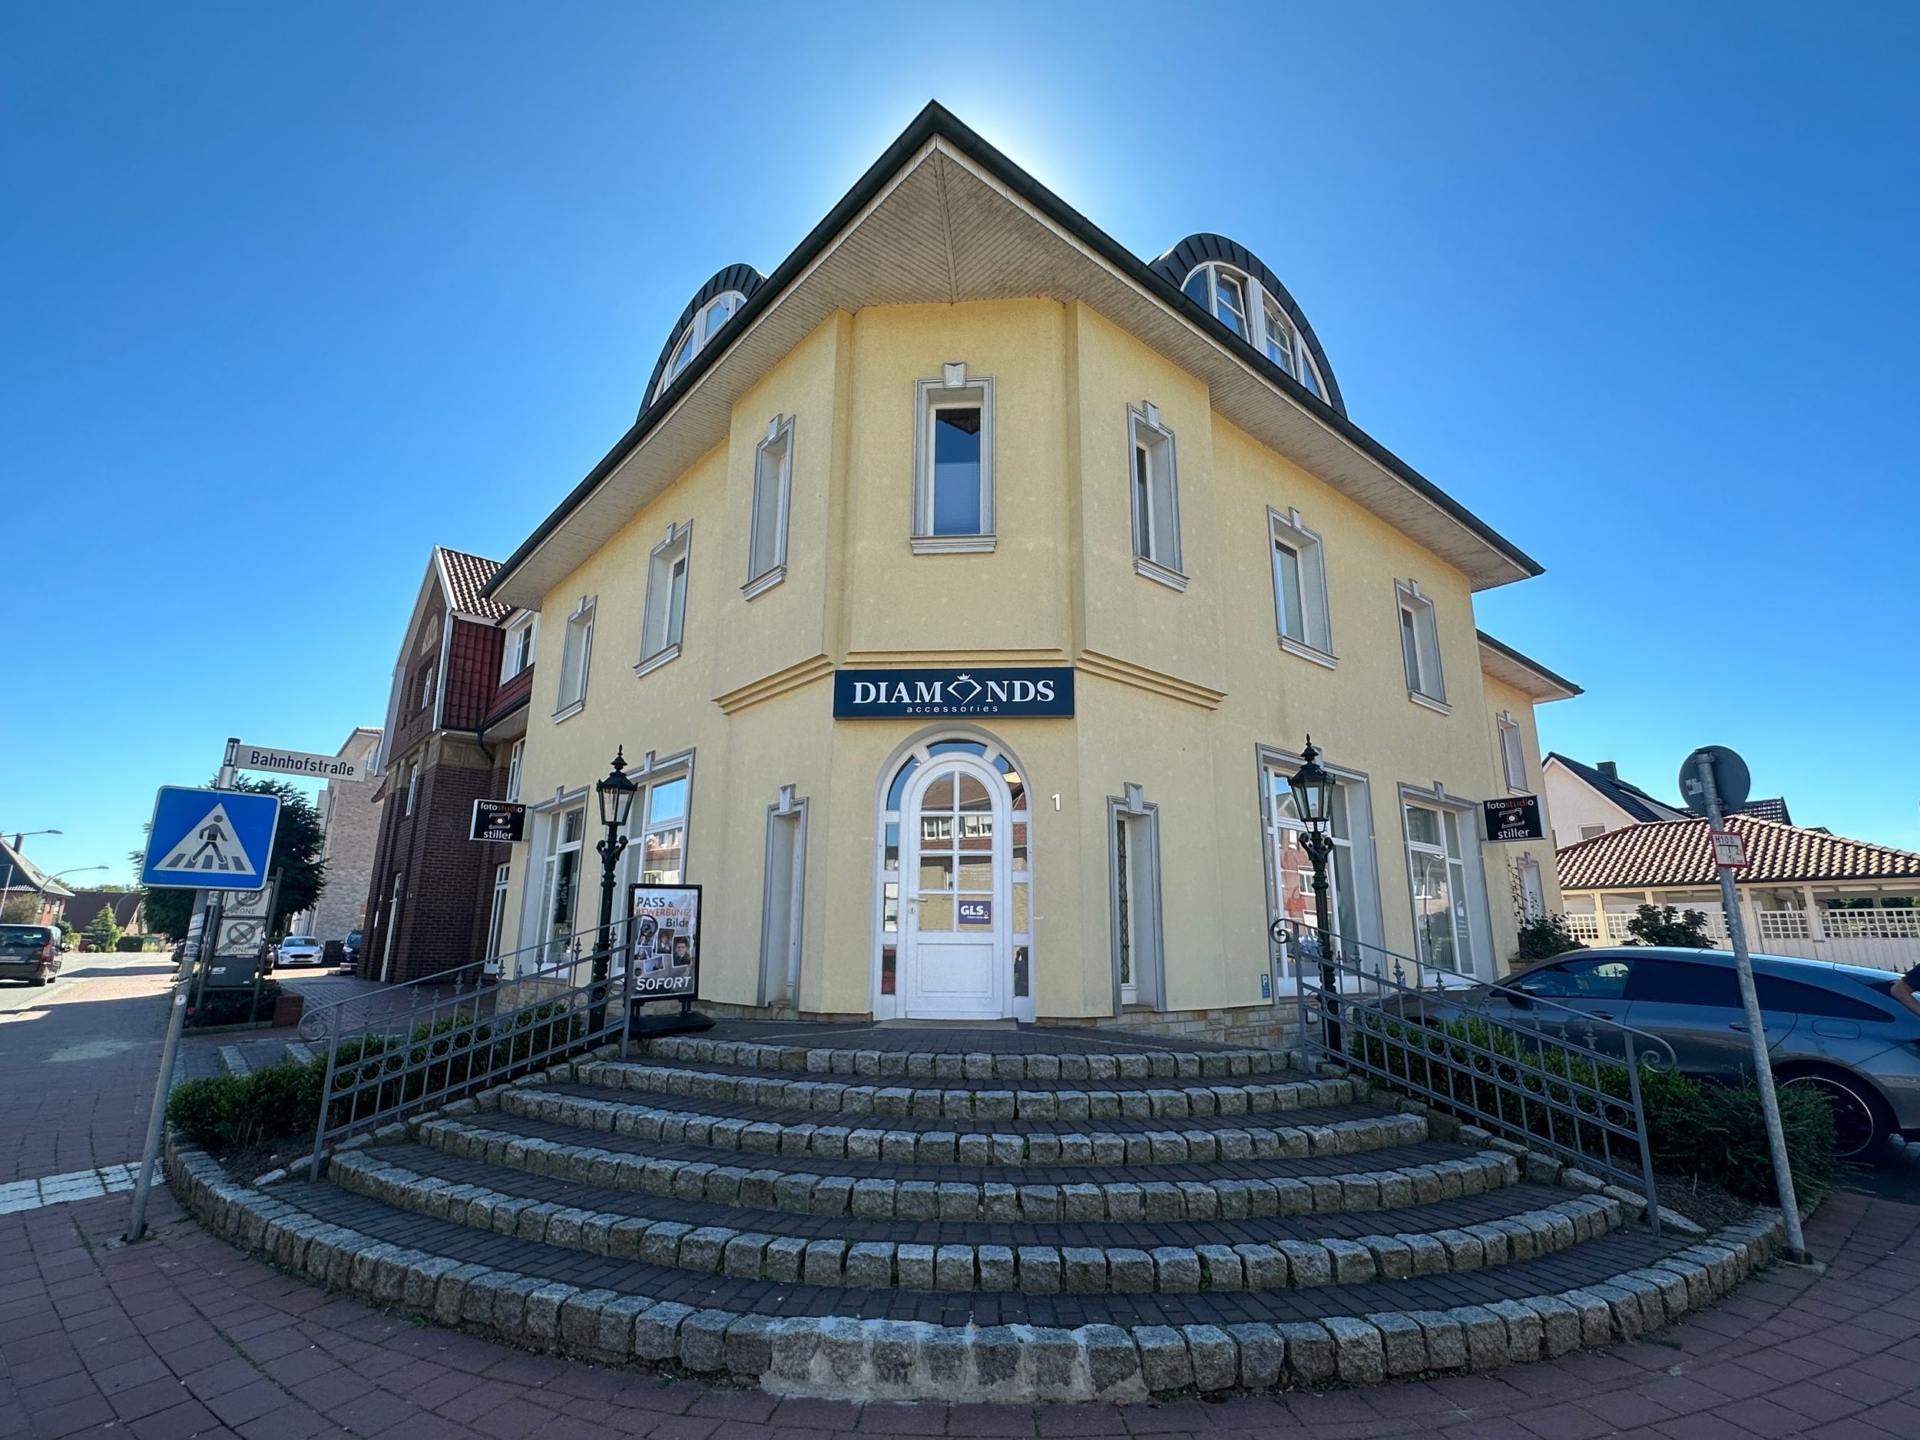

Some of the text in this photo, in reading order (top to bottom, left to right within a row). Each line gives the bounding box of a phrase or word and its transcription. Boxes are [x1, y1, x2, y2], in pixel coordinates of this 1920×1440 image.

[906, 704, 999, 713] accessories
[250, 751, 354, 776] Bahnhofstraße
[480, 802, 523, 813] fotostudio
[1051, 793, 1060, 811] 1
[1487, 799, 1534, 809] fotostudio
[483, 830, 513, 840] stiller
[1497, 828, 1530, 839] stiller
[1714, 835, 1735, 844] H100
[636, 897, 666, 908] PASS
[234, 907, 257, 915] ZONE
[960, 905, 984, 916] GLS
[636, 976, 692, 991] SOFORT
[1262, 975, 1268, 986] P
